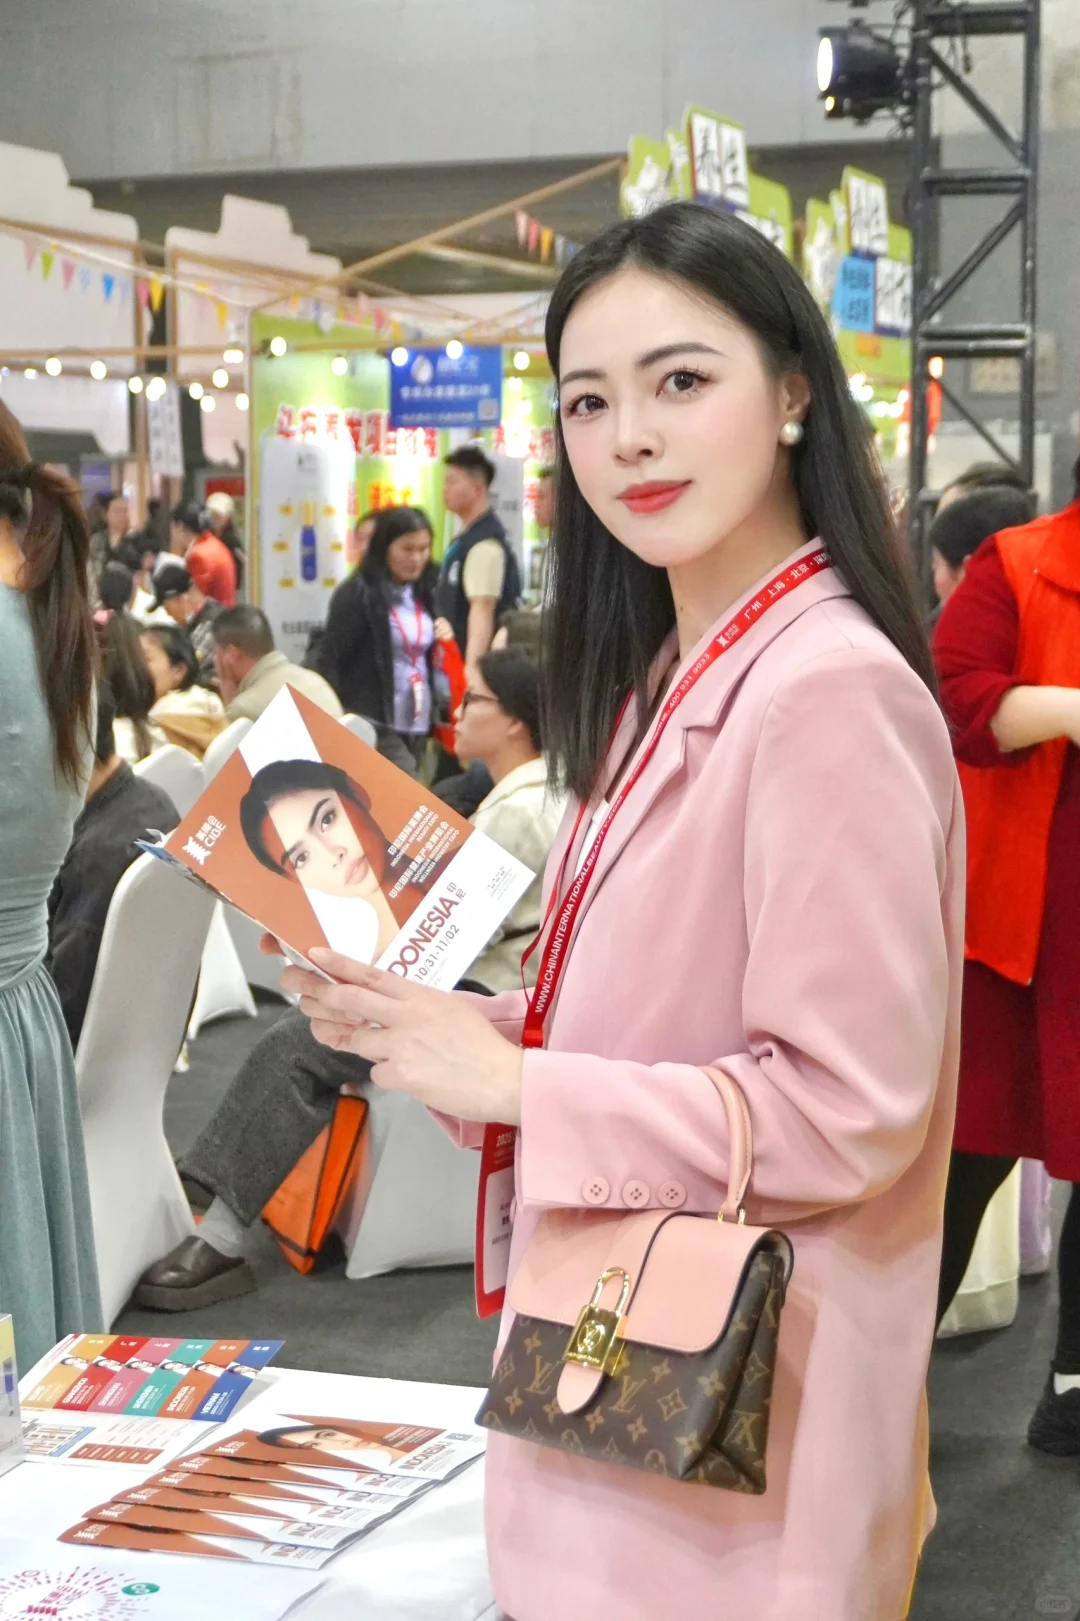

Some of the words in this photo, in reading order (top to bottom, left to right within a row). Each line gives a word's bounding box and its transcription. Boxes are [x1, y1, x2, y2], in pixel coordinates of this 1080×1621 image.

[669, 691, 681, 709] 400
[680, 674, 693, 691] 931
[204, 820, 227, 847] CIBE
[416, 826, 430, 843] BEAUTY
[427, 813, 439, 827] EXPO
